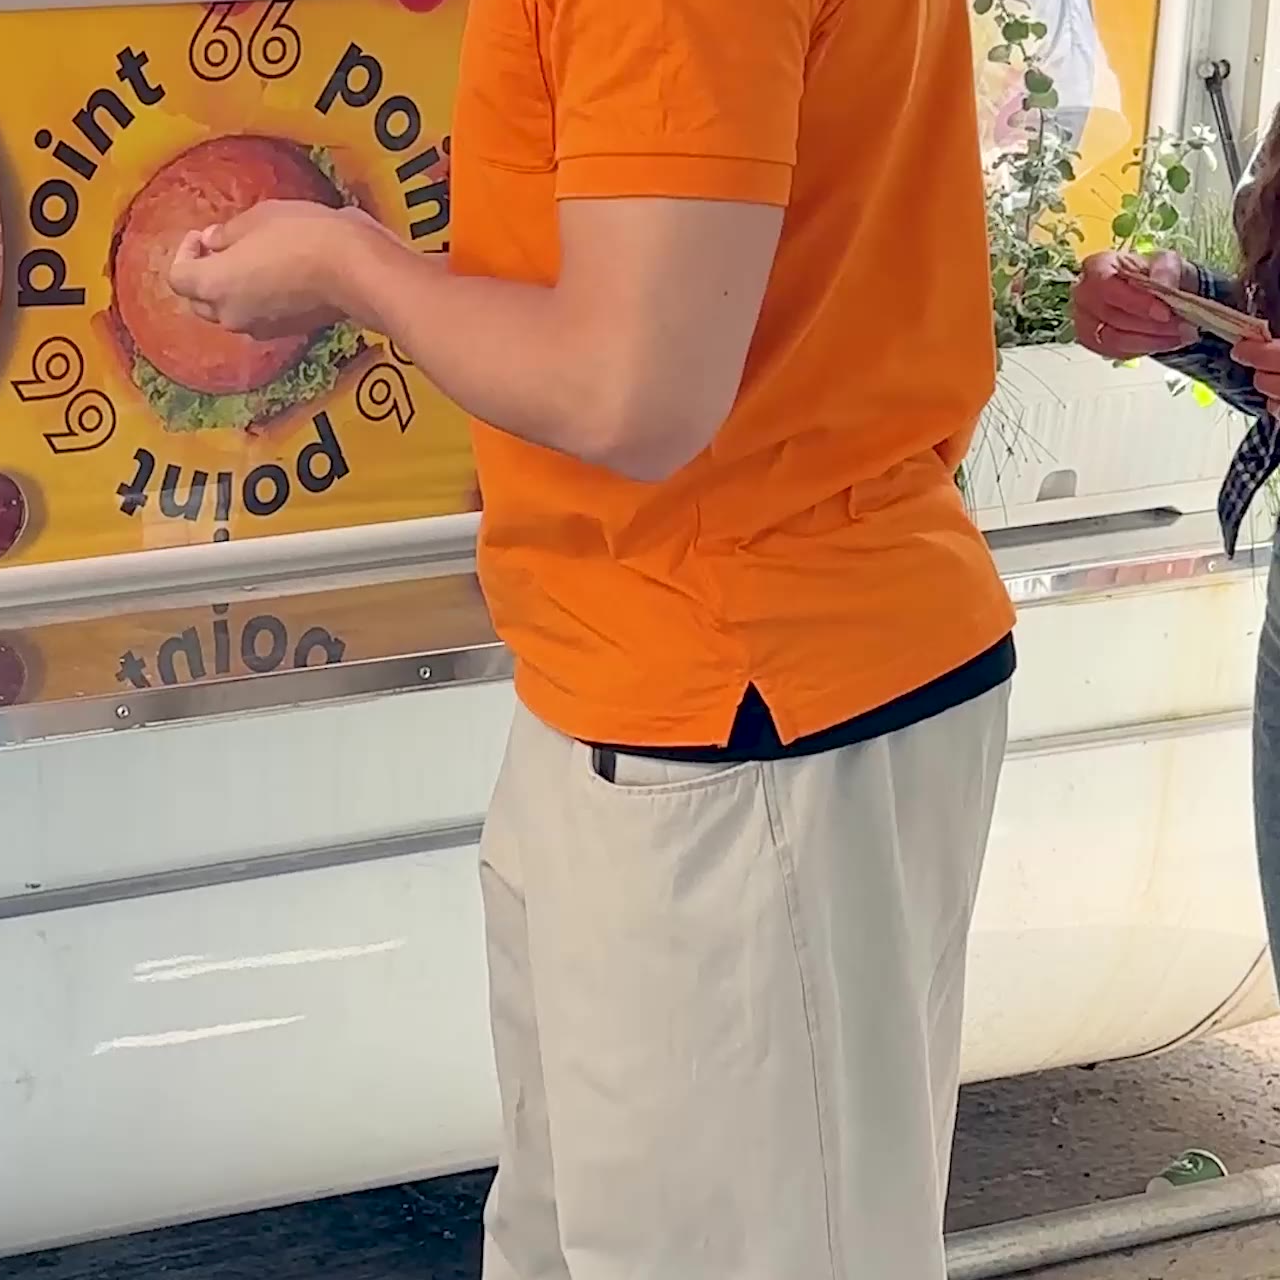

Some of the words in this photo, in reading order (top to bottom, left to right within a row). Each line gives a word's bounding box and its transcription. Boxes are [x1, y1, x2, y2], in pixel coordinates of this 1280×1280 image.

[189, 0, 302, 81] 66
[17, 45, 166, 308] point
[314, 41, 452, 255] poin
[10, 336, 116, 454] 66
[116, 411, 350, 544] point
